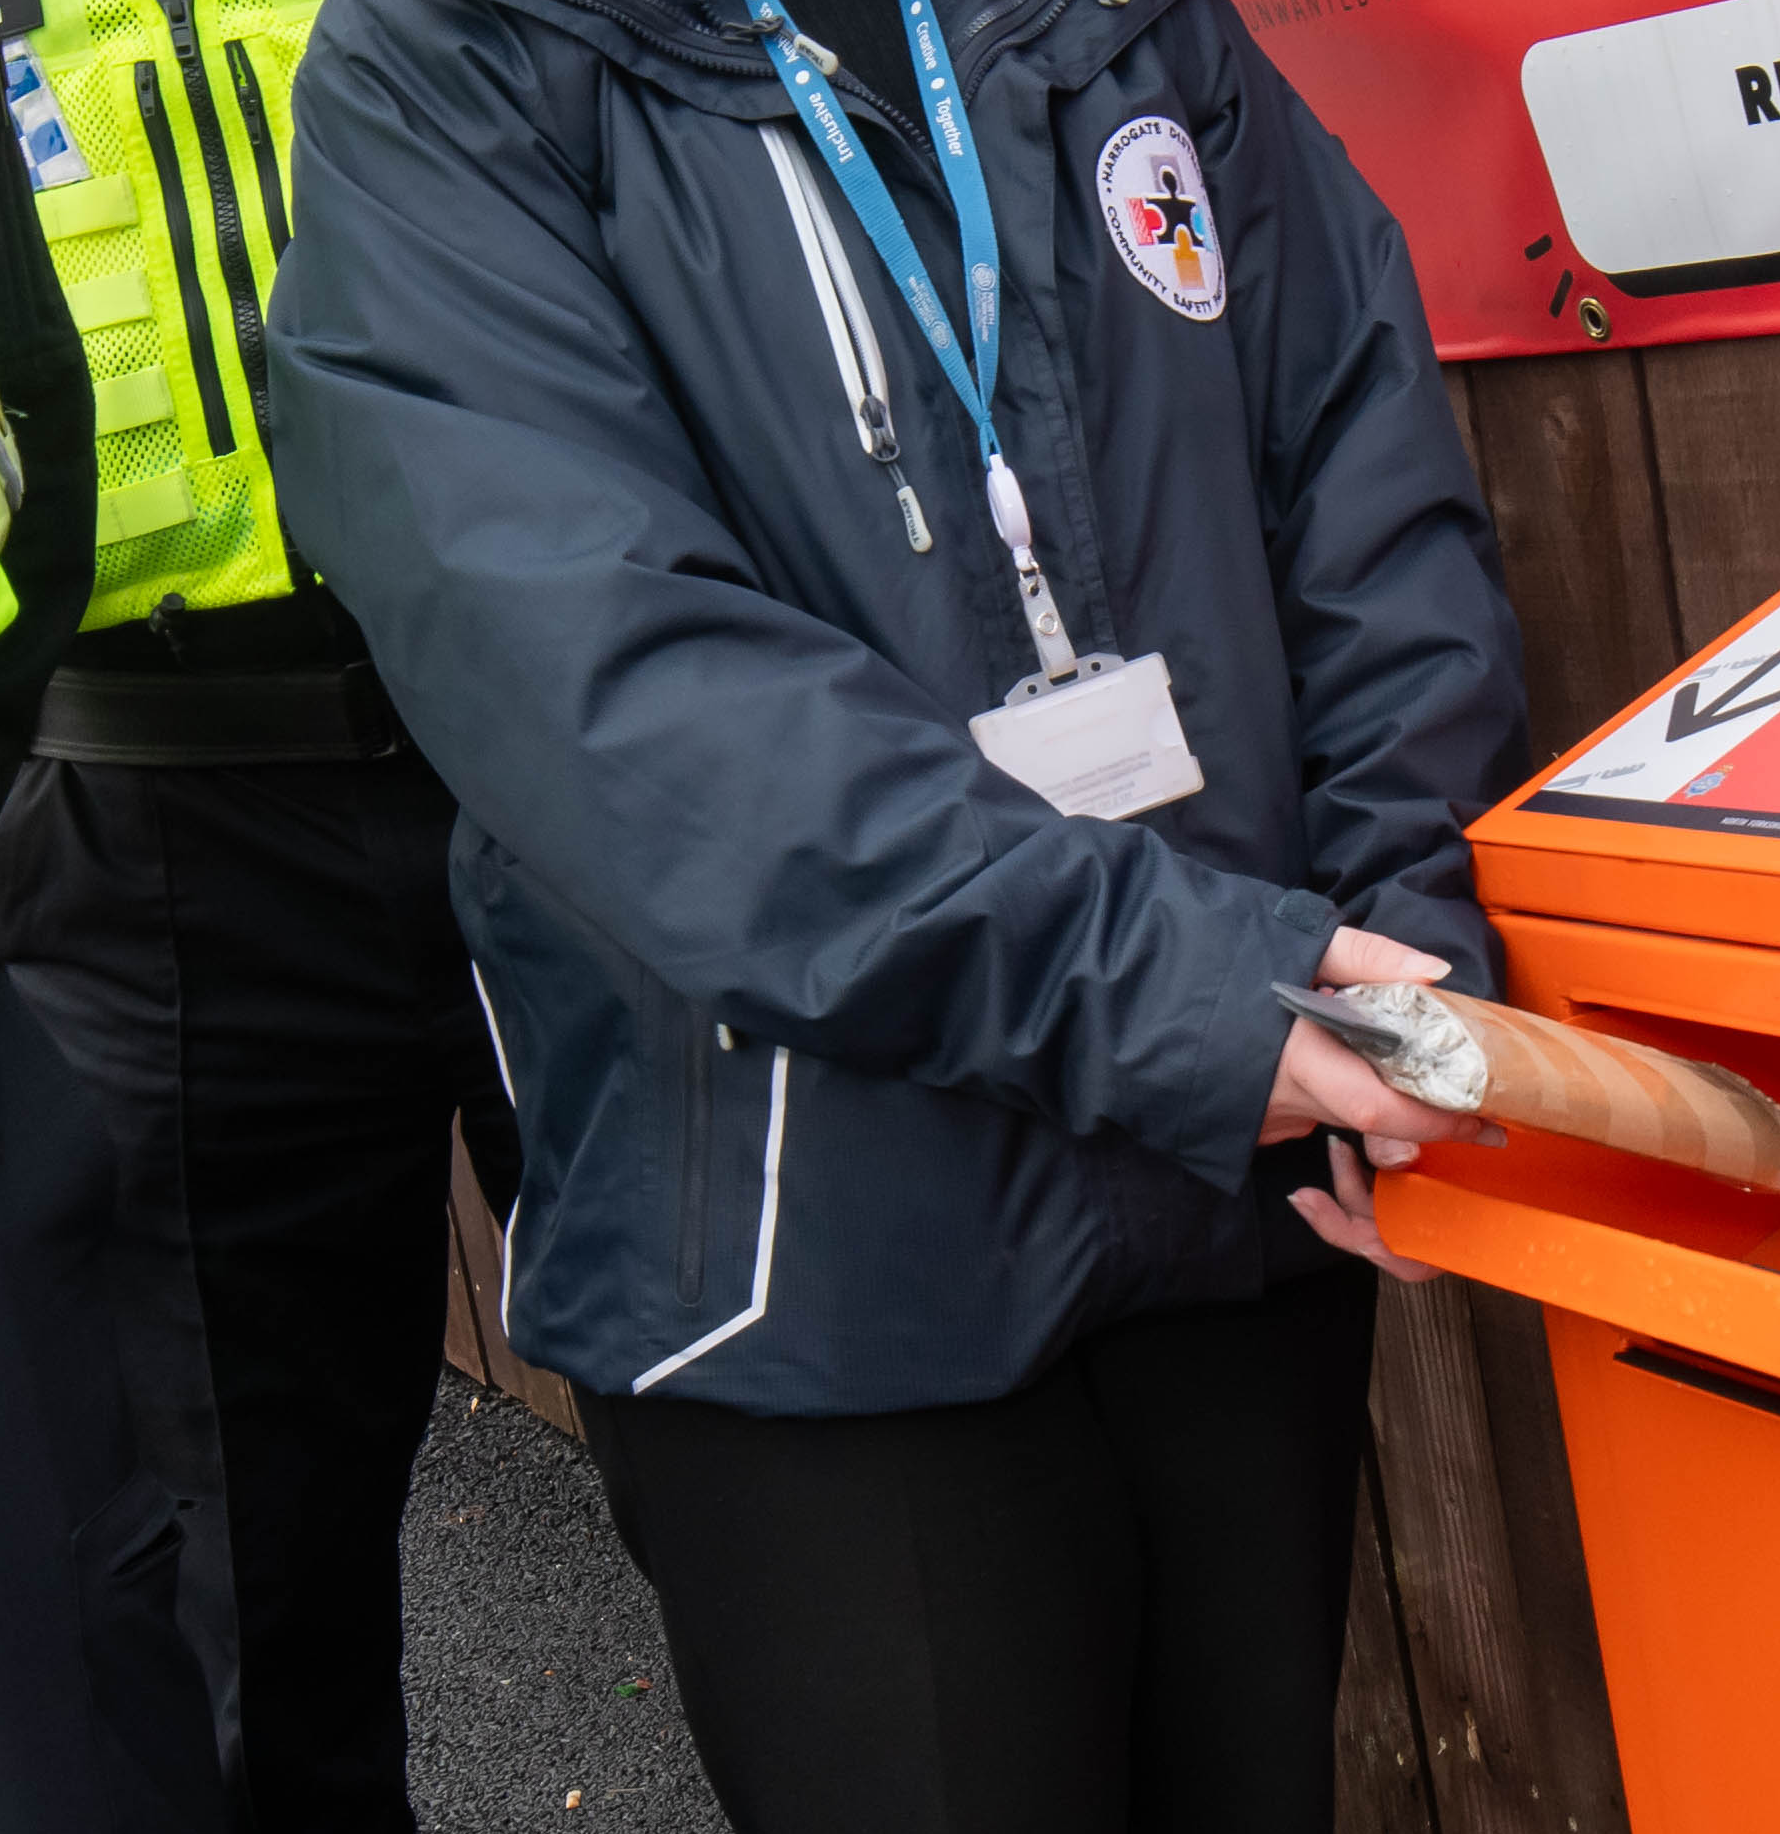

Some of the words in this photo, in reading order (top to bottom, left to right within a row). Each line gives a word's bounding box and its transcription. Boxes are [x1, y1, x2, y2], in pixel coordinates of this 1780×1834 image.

[808, 92, 855, 164] Inclusive
[916, 21, 938, 71] Creative
[936, 96, 964, 158] Together
[1102, 122, 1161, 183] HARROGATE
[1107, 205, 1167, 294] COMMUNITY
[1173, 292, 1212, 314] SAFETY
